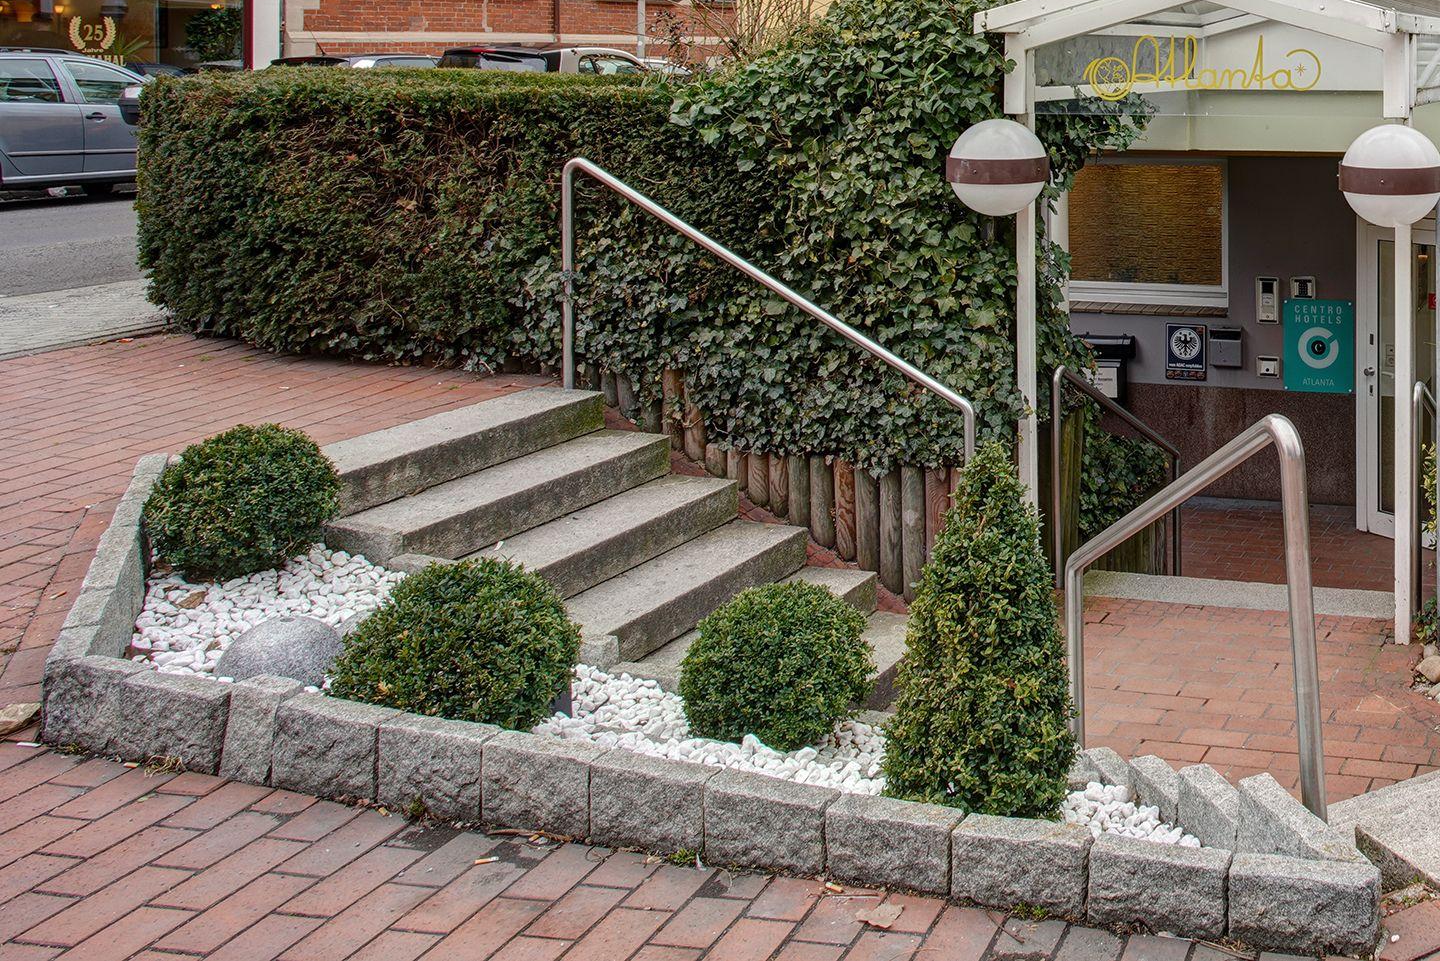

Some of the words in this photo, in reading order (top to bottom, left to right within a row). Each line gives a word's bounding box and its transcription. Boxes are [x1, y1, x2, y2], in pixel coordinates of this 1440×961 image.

[83, 24, 104, 41] 25
[1130, 34, 1322, 92] Atlanta
[1294, 305, 1342, 315] CENTRO
[1295, 314, 1342, 324] HOTELS
[1302, 378, 1335, 386] ATLANTA
